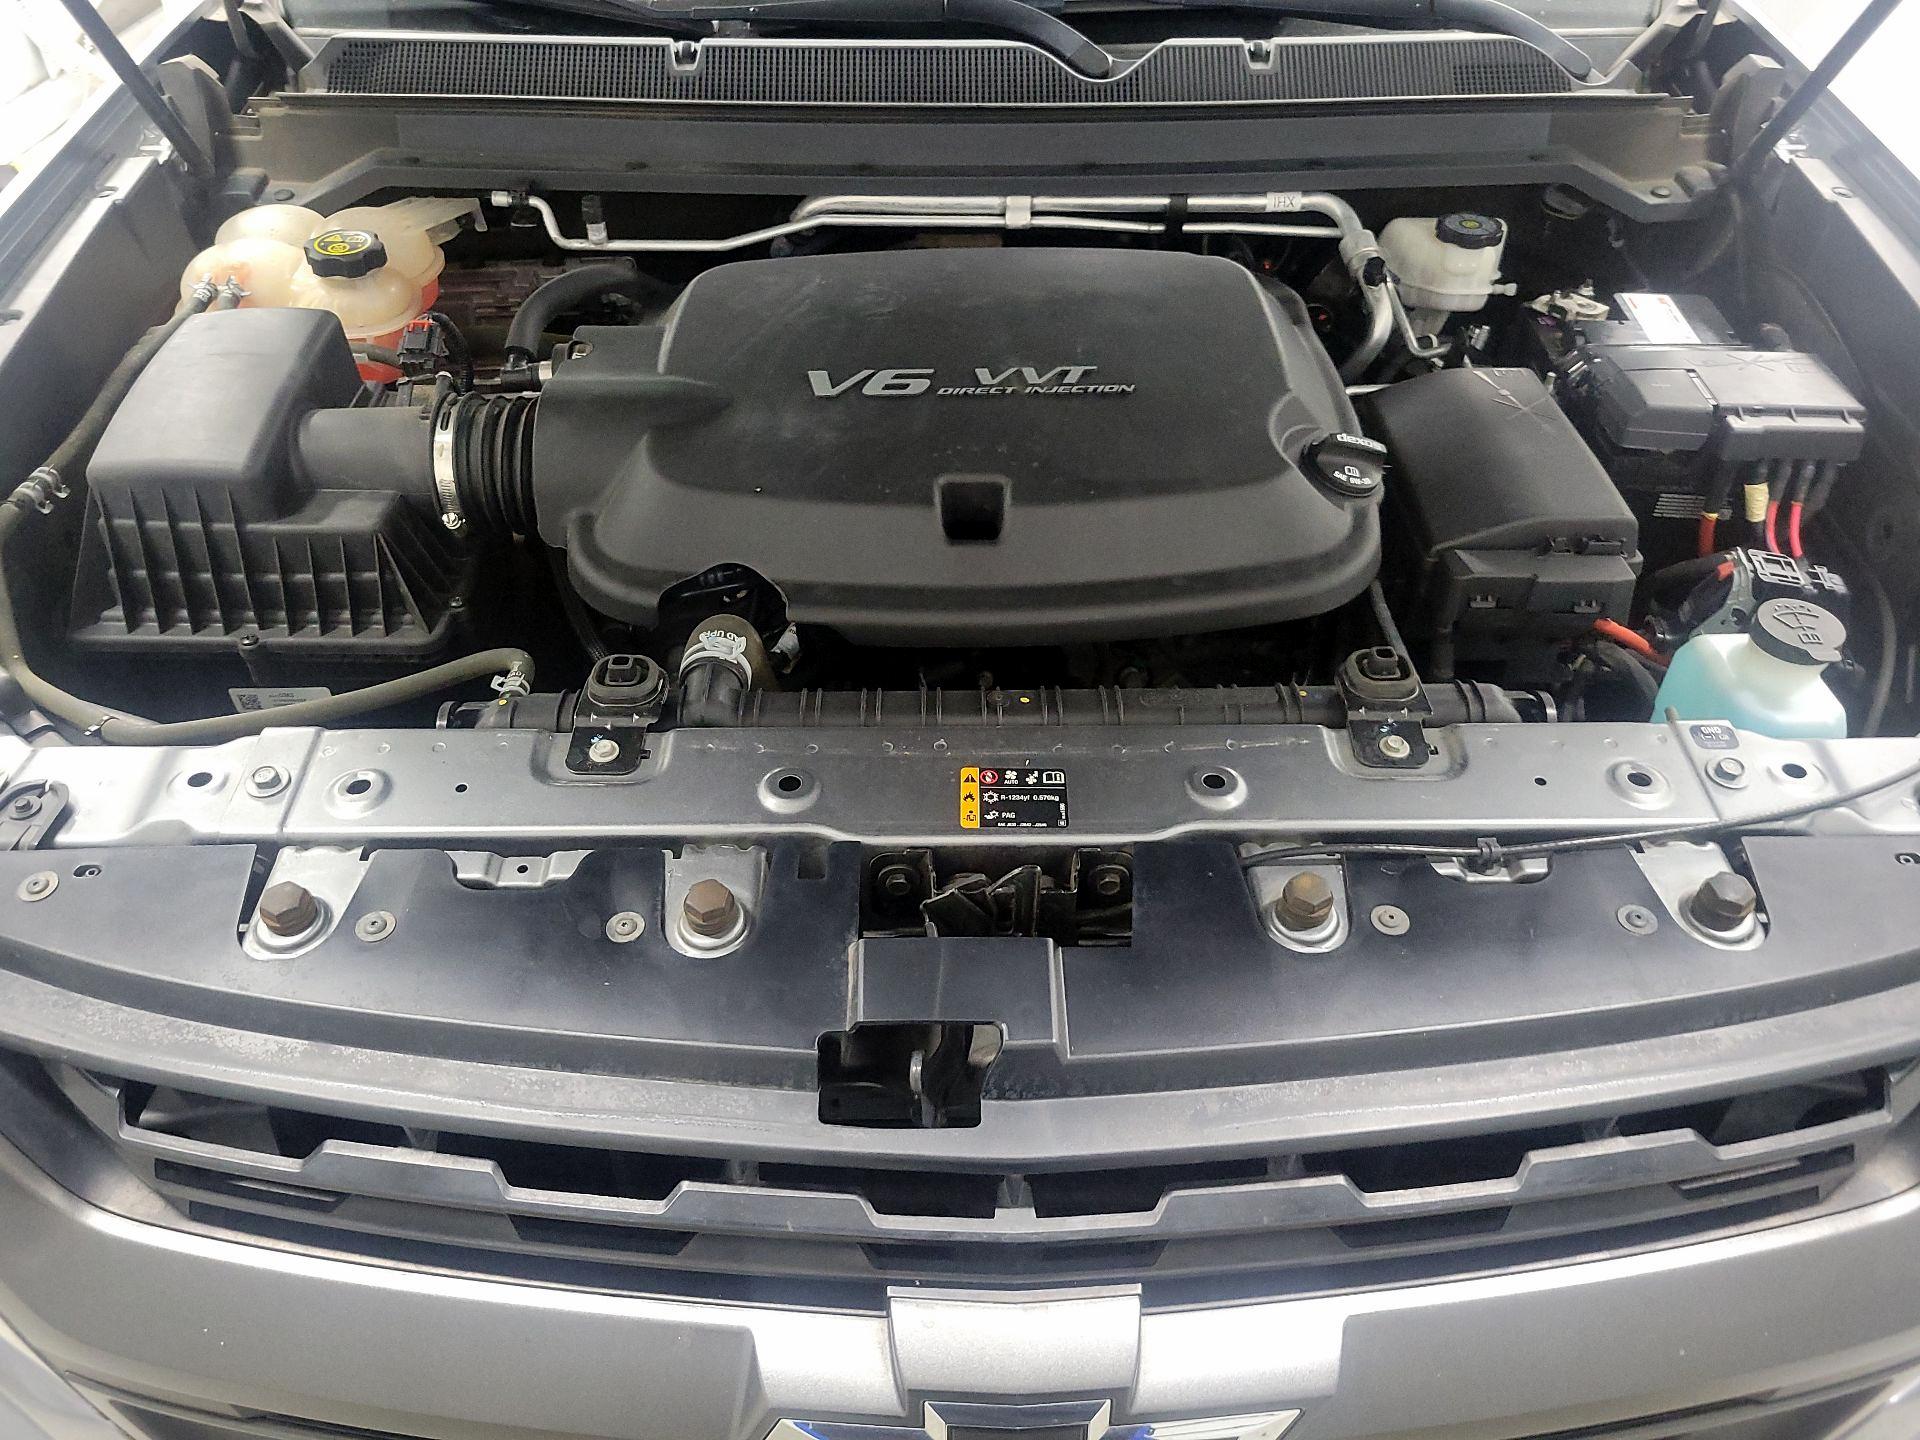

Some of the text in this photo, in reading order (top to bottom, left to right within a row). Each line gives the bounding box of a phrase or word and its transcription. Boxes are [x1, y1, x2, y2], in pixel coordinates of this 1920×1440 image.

[807, 365, 1098, 397] V6 VVT
[936, 384, 1136, 395] DIRECT INJECTION
[1700, 726, 1722, 734] GND
[1000, 794, 1030, 802] R-1234yf
